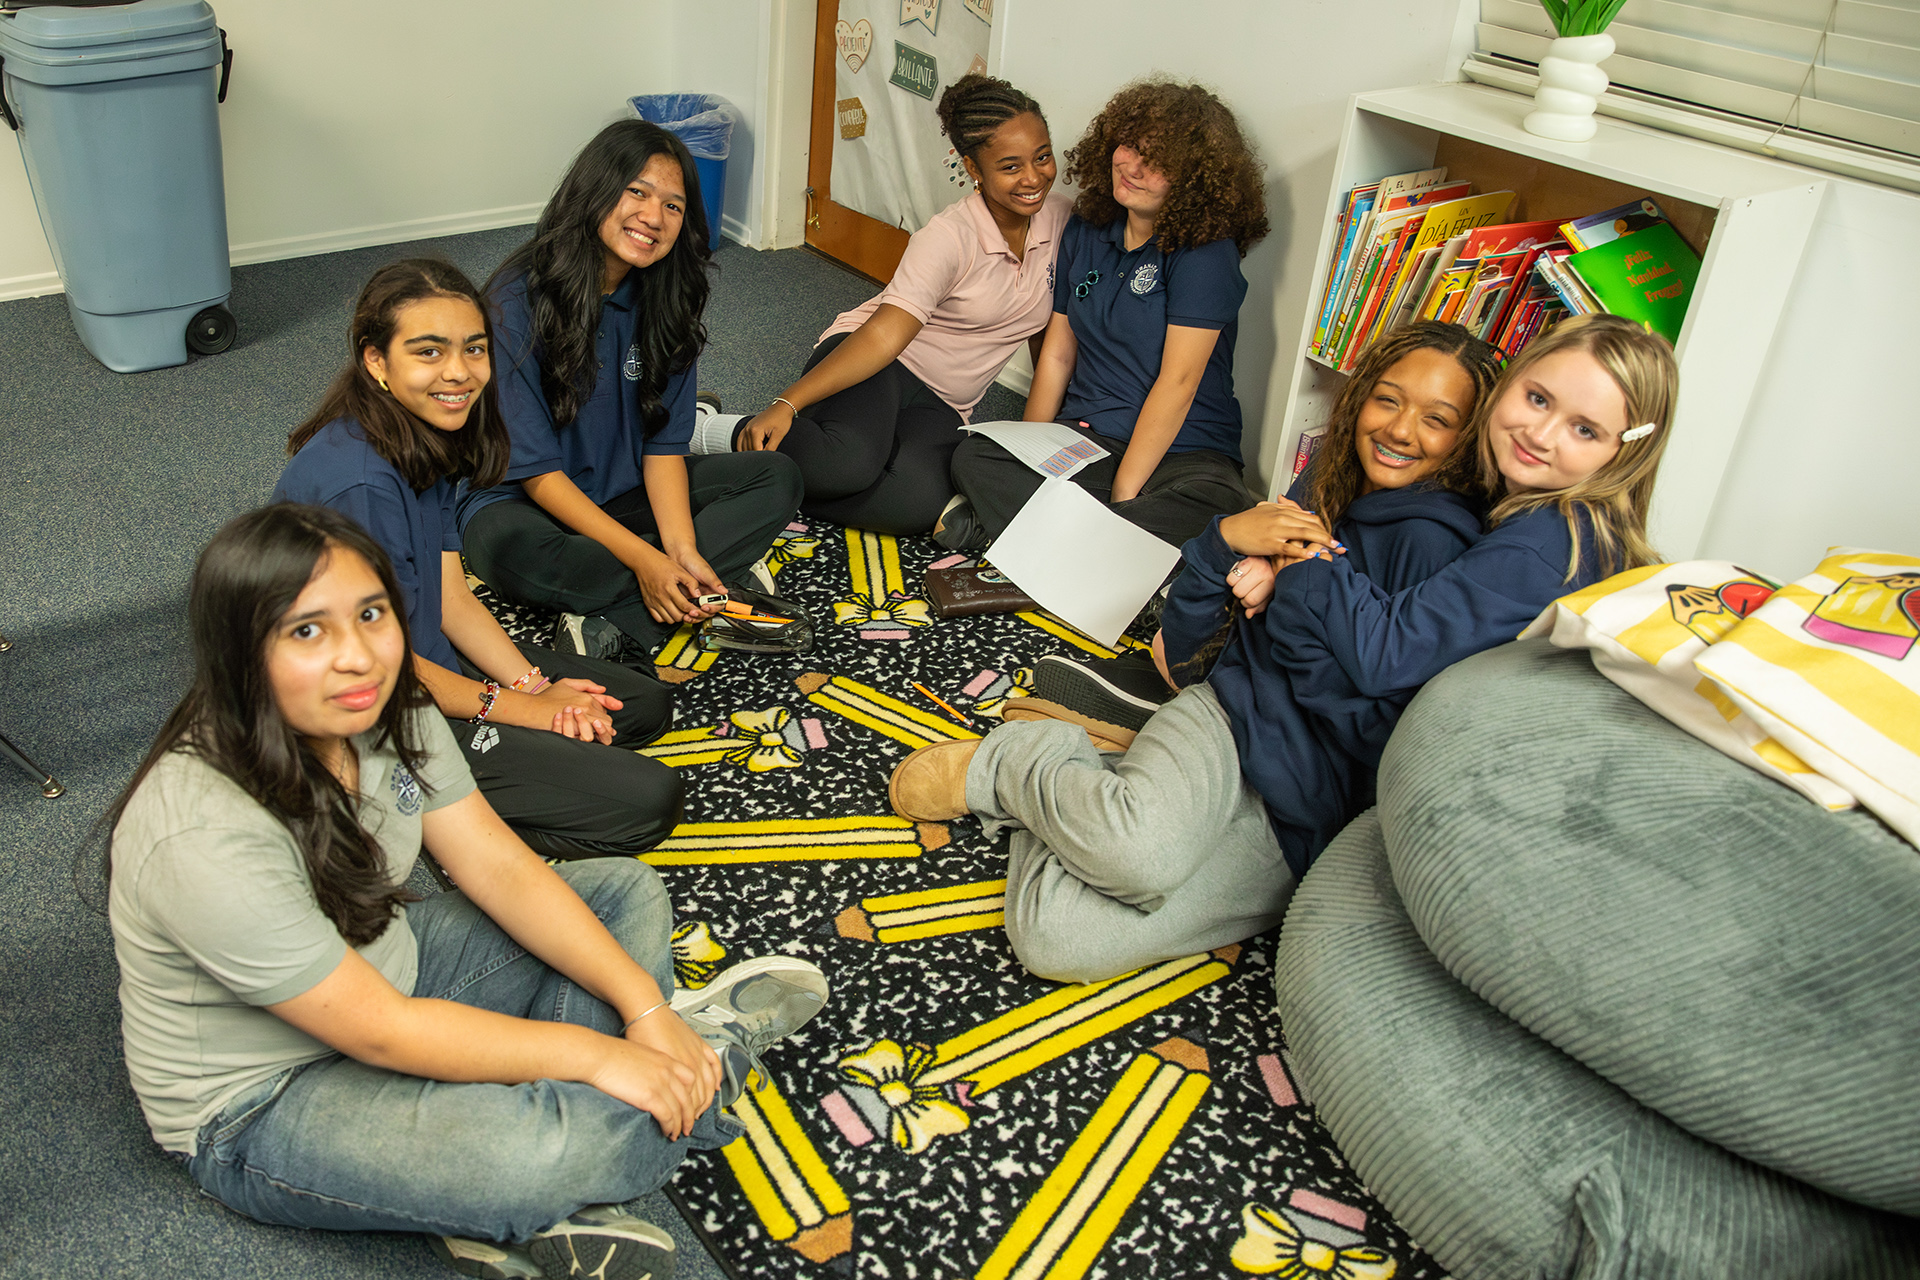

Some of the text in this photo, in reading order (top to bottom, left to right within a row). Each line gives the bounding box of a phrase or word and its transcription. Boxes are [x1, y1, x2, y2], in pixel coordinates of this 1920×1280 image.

[840, 35, 867, 53] PACIENTE
[897, 56, 934, 90] BRILLANTE
[1396, 180, 1404, 189] EL
[1459, 207, 1472, 217] UN
[1420, 218, 1448, 246] DÍA
[1449, 212, 1497, 238] FELIZ
[470, 725, 491, 751] arena
